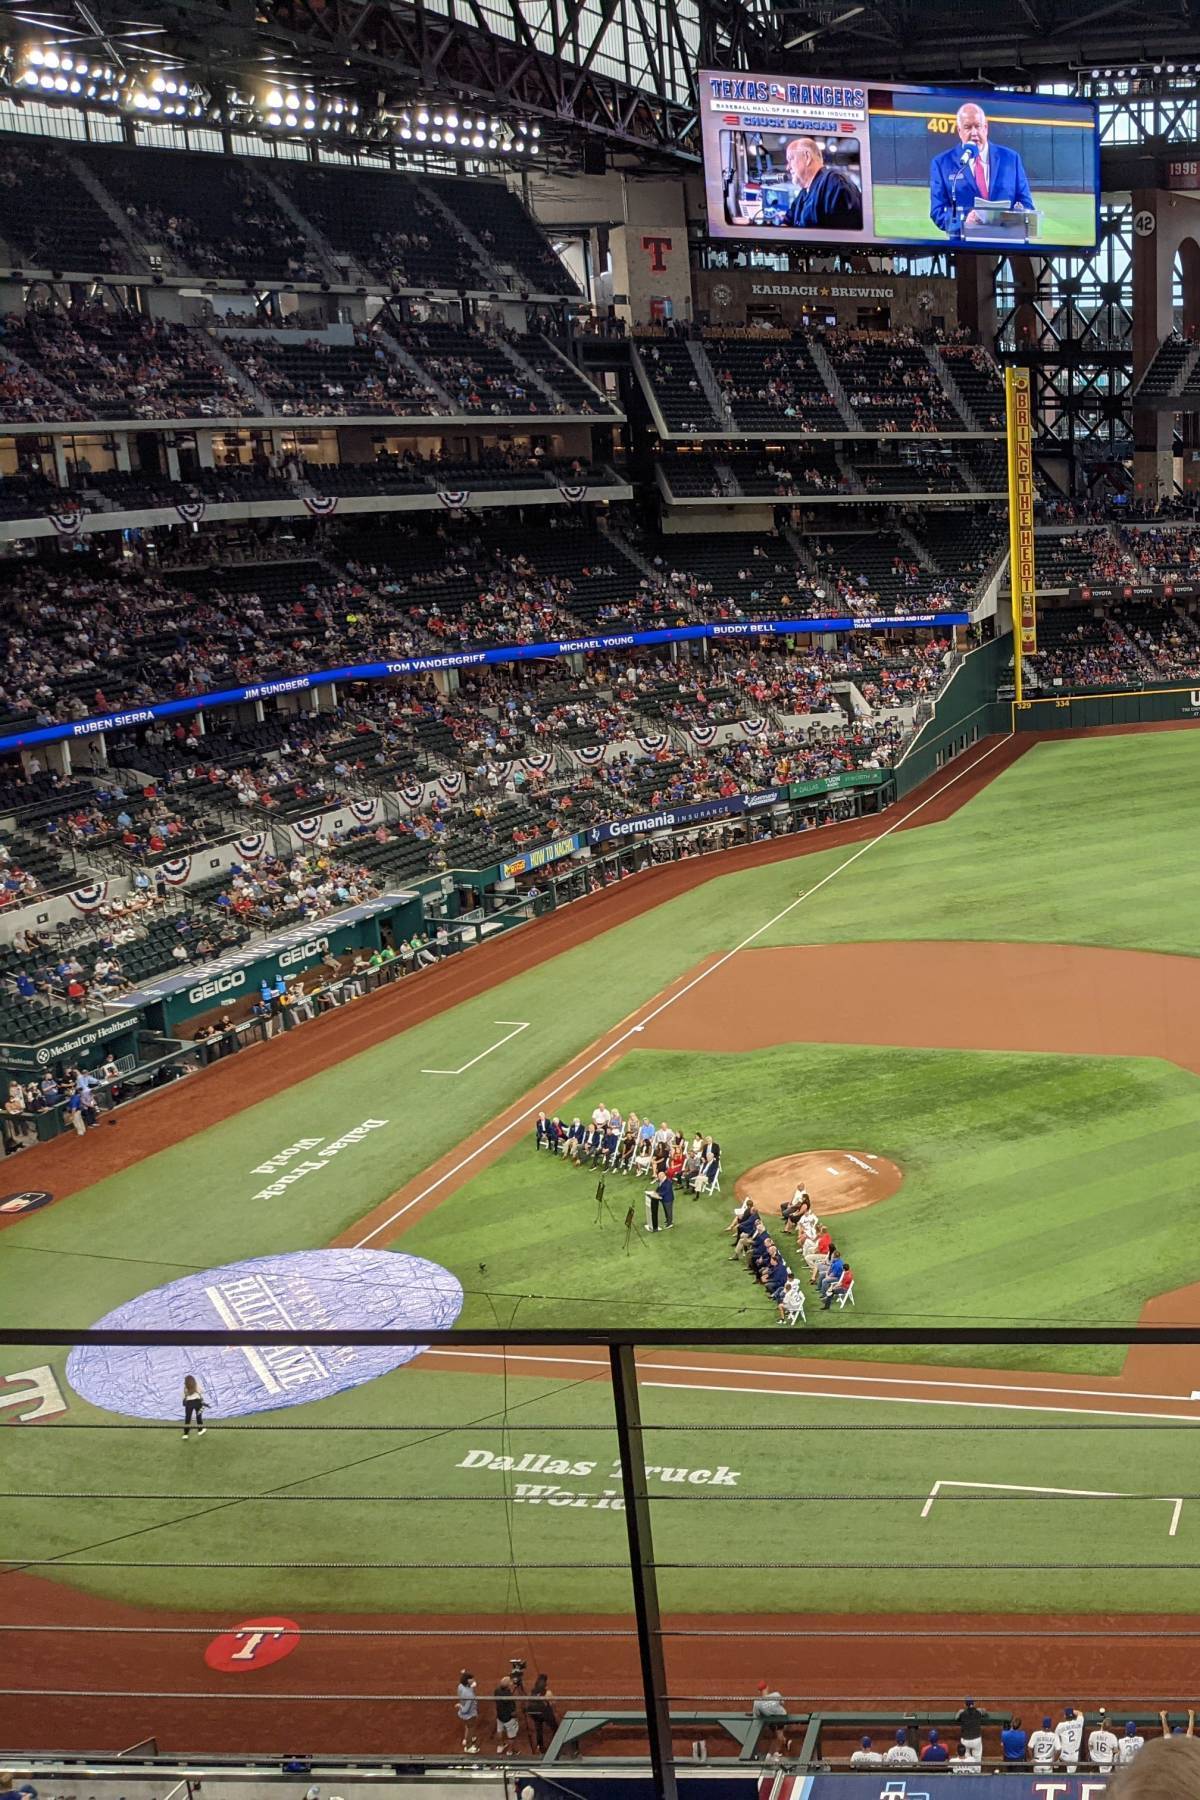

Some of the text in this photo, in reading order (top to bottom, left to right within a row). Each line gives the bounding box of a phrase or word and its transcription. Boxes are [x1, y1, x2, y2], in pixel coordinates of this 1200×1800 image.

[710, 78, 865, 108] TEXAS RANGERS
[716, 103, 750, 112] BASEBALL
[752, 105, 770, 113] HALL
[743, 117, 837, 131] CHUCK MORGAN
[928, 117, 957, 134] 407
[1170, 162, 1197, 175] 1996
[1135, 215, 1153, 231] 42
[641, 236, 673, 272] T
[752, 284, 894, 298] KARBACH BREWING
[1017, 393, 1030, 474] BRING
[1019, 479, 1031, 526] THE
[1021, 531, 1033, 592] HEAT
[714, 623, 776, 634] BUDDY BELL
[560, 636, 634, 652] MICHAEL YOUNG
[387, 654, 486, 673] TOM VANDERGRIFF
[244, 678, 309, 700] JIM SUNDBERG
[74, 711, 155, 735] RUBEN SIERRA
[609, 806, 729, 836] Germania INSURANCE
[530, 850, 545, 868] HOW
[279, 938, 328, 968] GEICO
[189, 970, 246, 1004] GEICO
[51, 1016, 138, 1057] Medical City Healthcare
[249, 1137, 325, 1175] World
[251, 1118, 389, 1200] Dallas Truck
[456, 1450, 597, 1476] Dallas
[231, 1626, 284, 1660] T
[1068, 1730, 1075, 1743] 2
[1096, 1741, 1107, 1753] 16
[1037, 1743, 1053, 1754] 27
